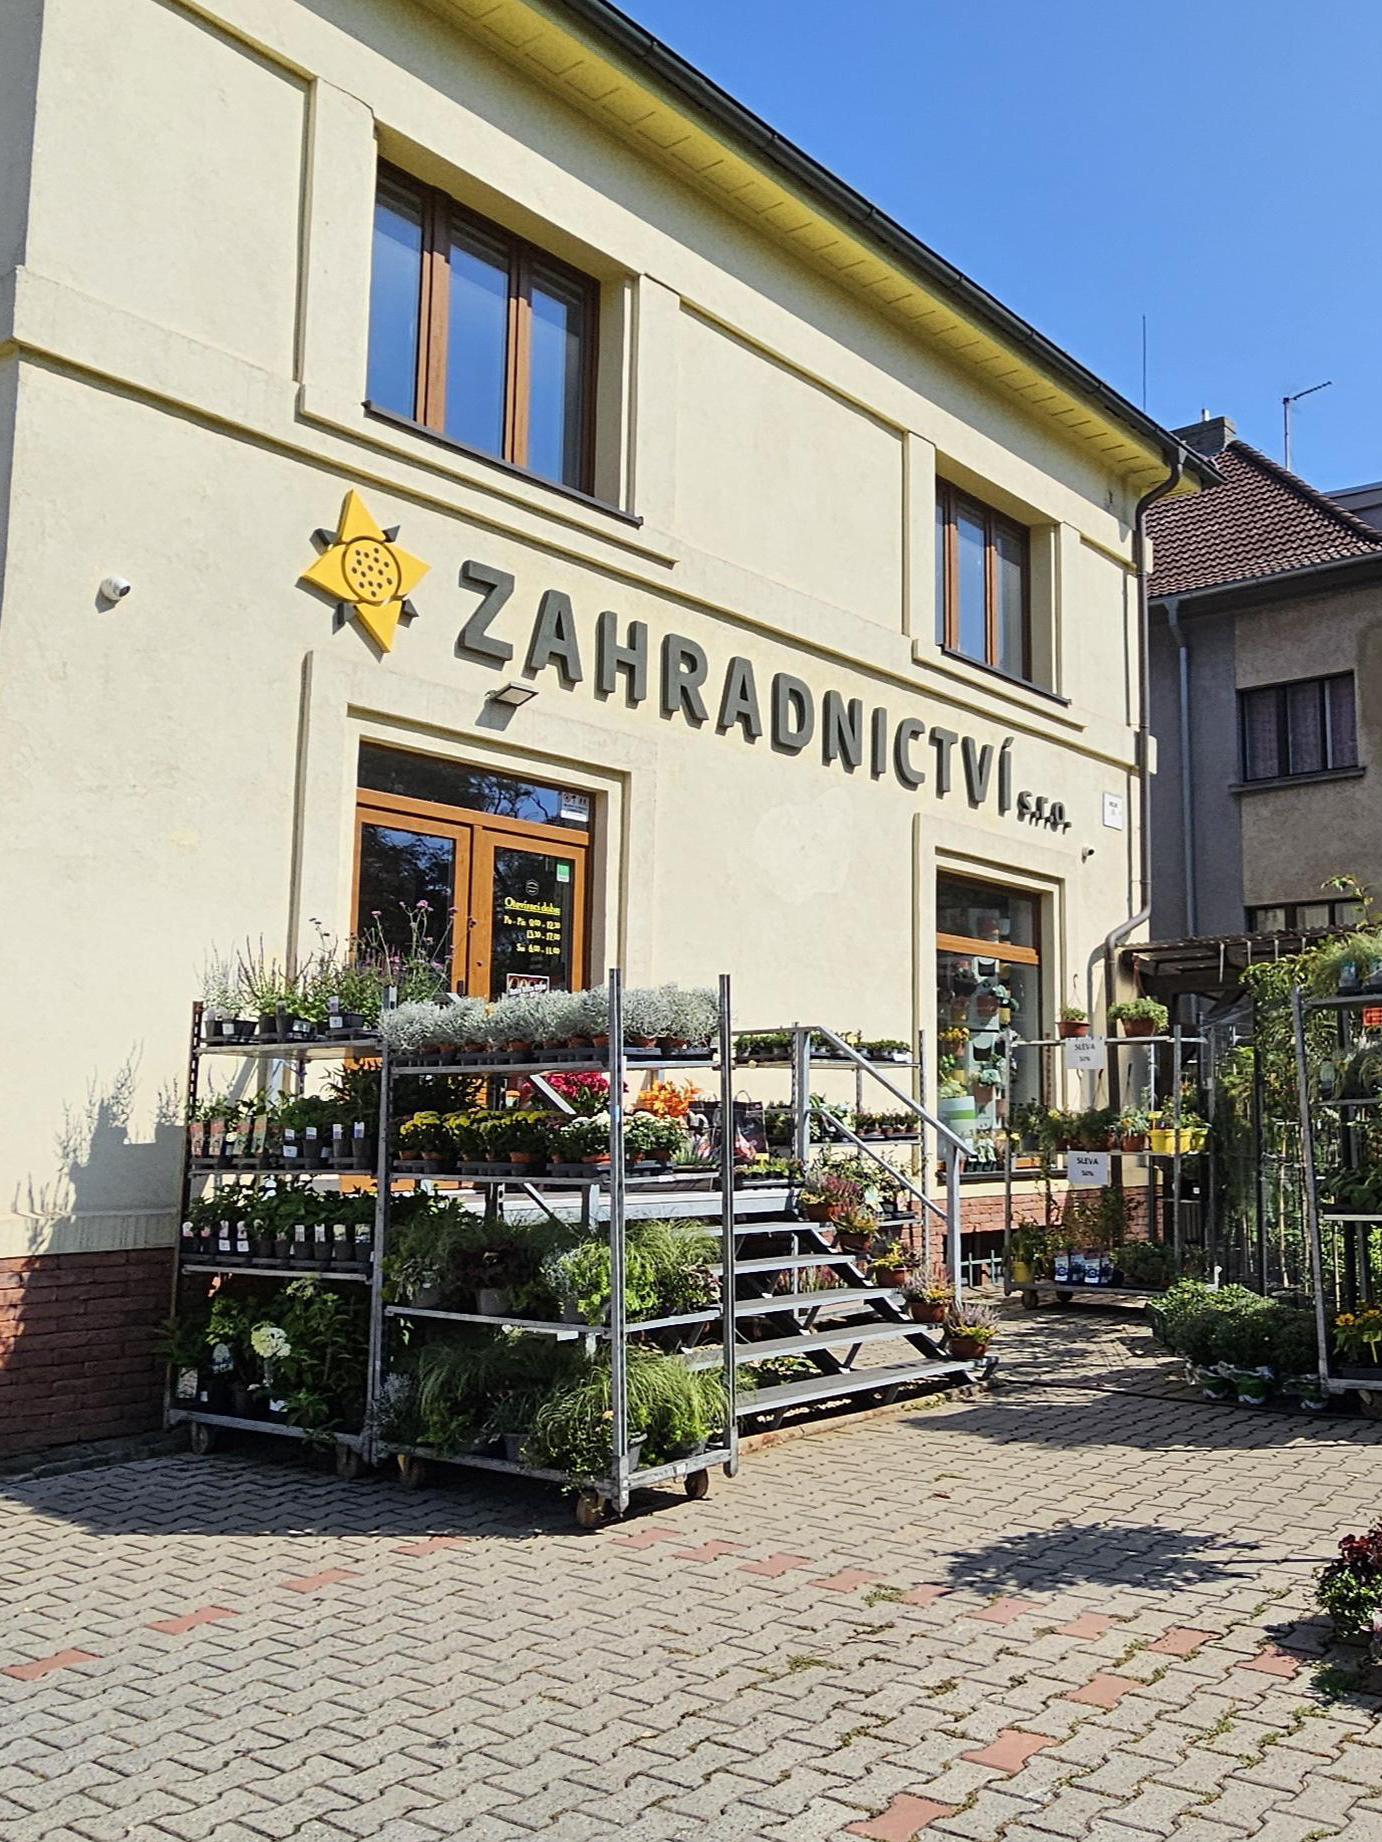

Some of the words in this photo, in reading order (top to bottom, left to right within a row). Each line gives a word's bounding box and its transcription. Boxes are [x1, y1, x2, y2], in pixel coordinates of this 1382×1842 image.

[455, 560, 1013, 816] ZAHRADNICTVÍ
[1017, 791, 1072, 828] s.r.o.
[1075, 1043, 1096, 1051] SLEVA
[1077, 1157, 1099, 1167] SLEVA
